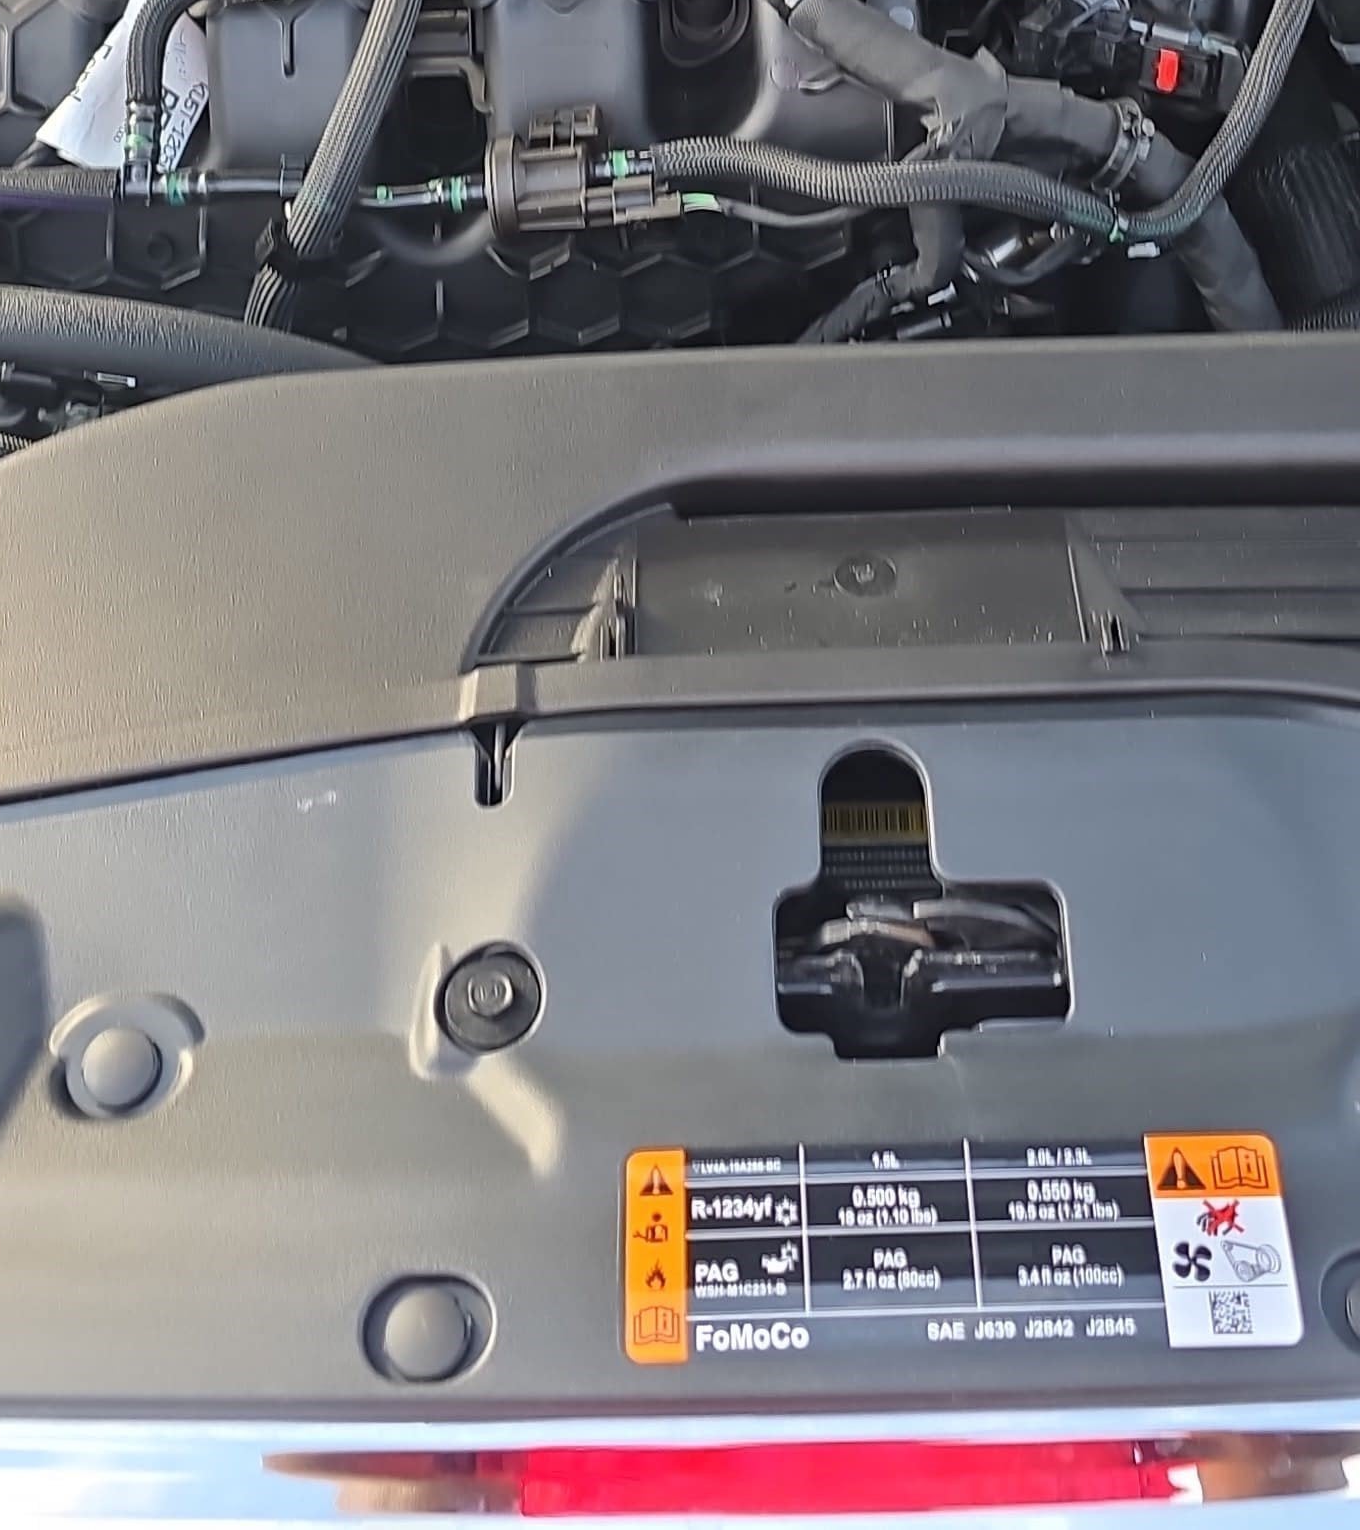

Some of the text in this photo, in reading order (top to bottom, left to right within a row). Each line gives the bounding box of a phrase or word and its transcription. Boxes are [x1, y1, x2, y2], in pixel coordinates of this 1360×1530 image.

[852, 1183, 921, 1211] 0.500 kg
[1027, 1178, 1096, 1205] 0.550 kg
[691, 1193, 773, 1223] R-1234yf
[838, 1206, 855, 1227] 18
[857, 1210, 875, 1227] oz
[910, 1204, 938, 1227] lbs)
[1038, 1203, 1056, 1221] oz
[1092, 1199, 1120, 1222] lbs)
[873, 1247, 908, 1270] PAG
[1052, 1243, 1087, 1267] PAG
[695, 1259, 740, 1284] PAG
[842, 1268, 864, 1291] 2.7
[878, 1270, 897, 1290] oz
[1018, 1265, 1040, 1287] 3.4
[1053, 1268, 1071, 1286] oz
[1072, 1262, 1125, 1289] (100cc)
[695, 1321, 810, 1352] FoMoCo
[927, 1319, 966, 1341] SAE
[974, 1317, 1017, 1340] J639
